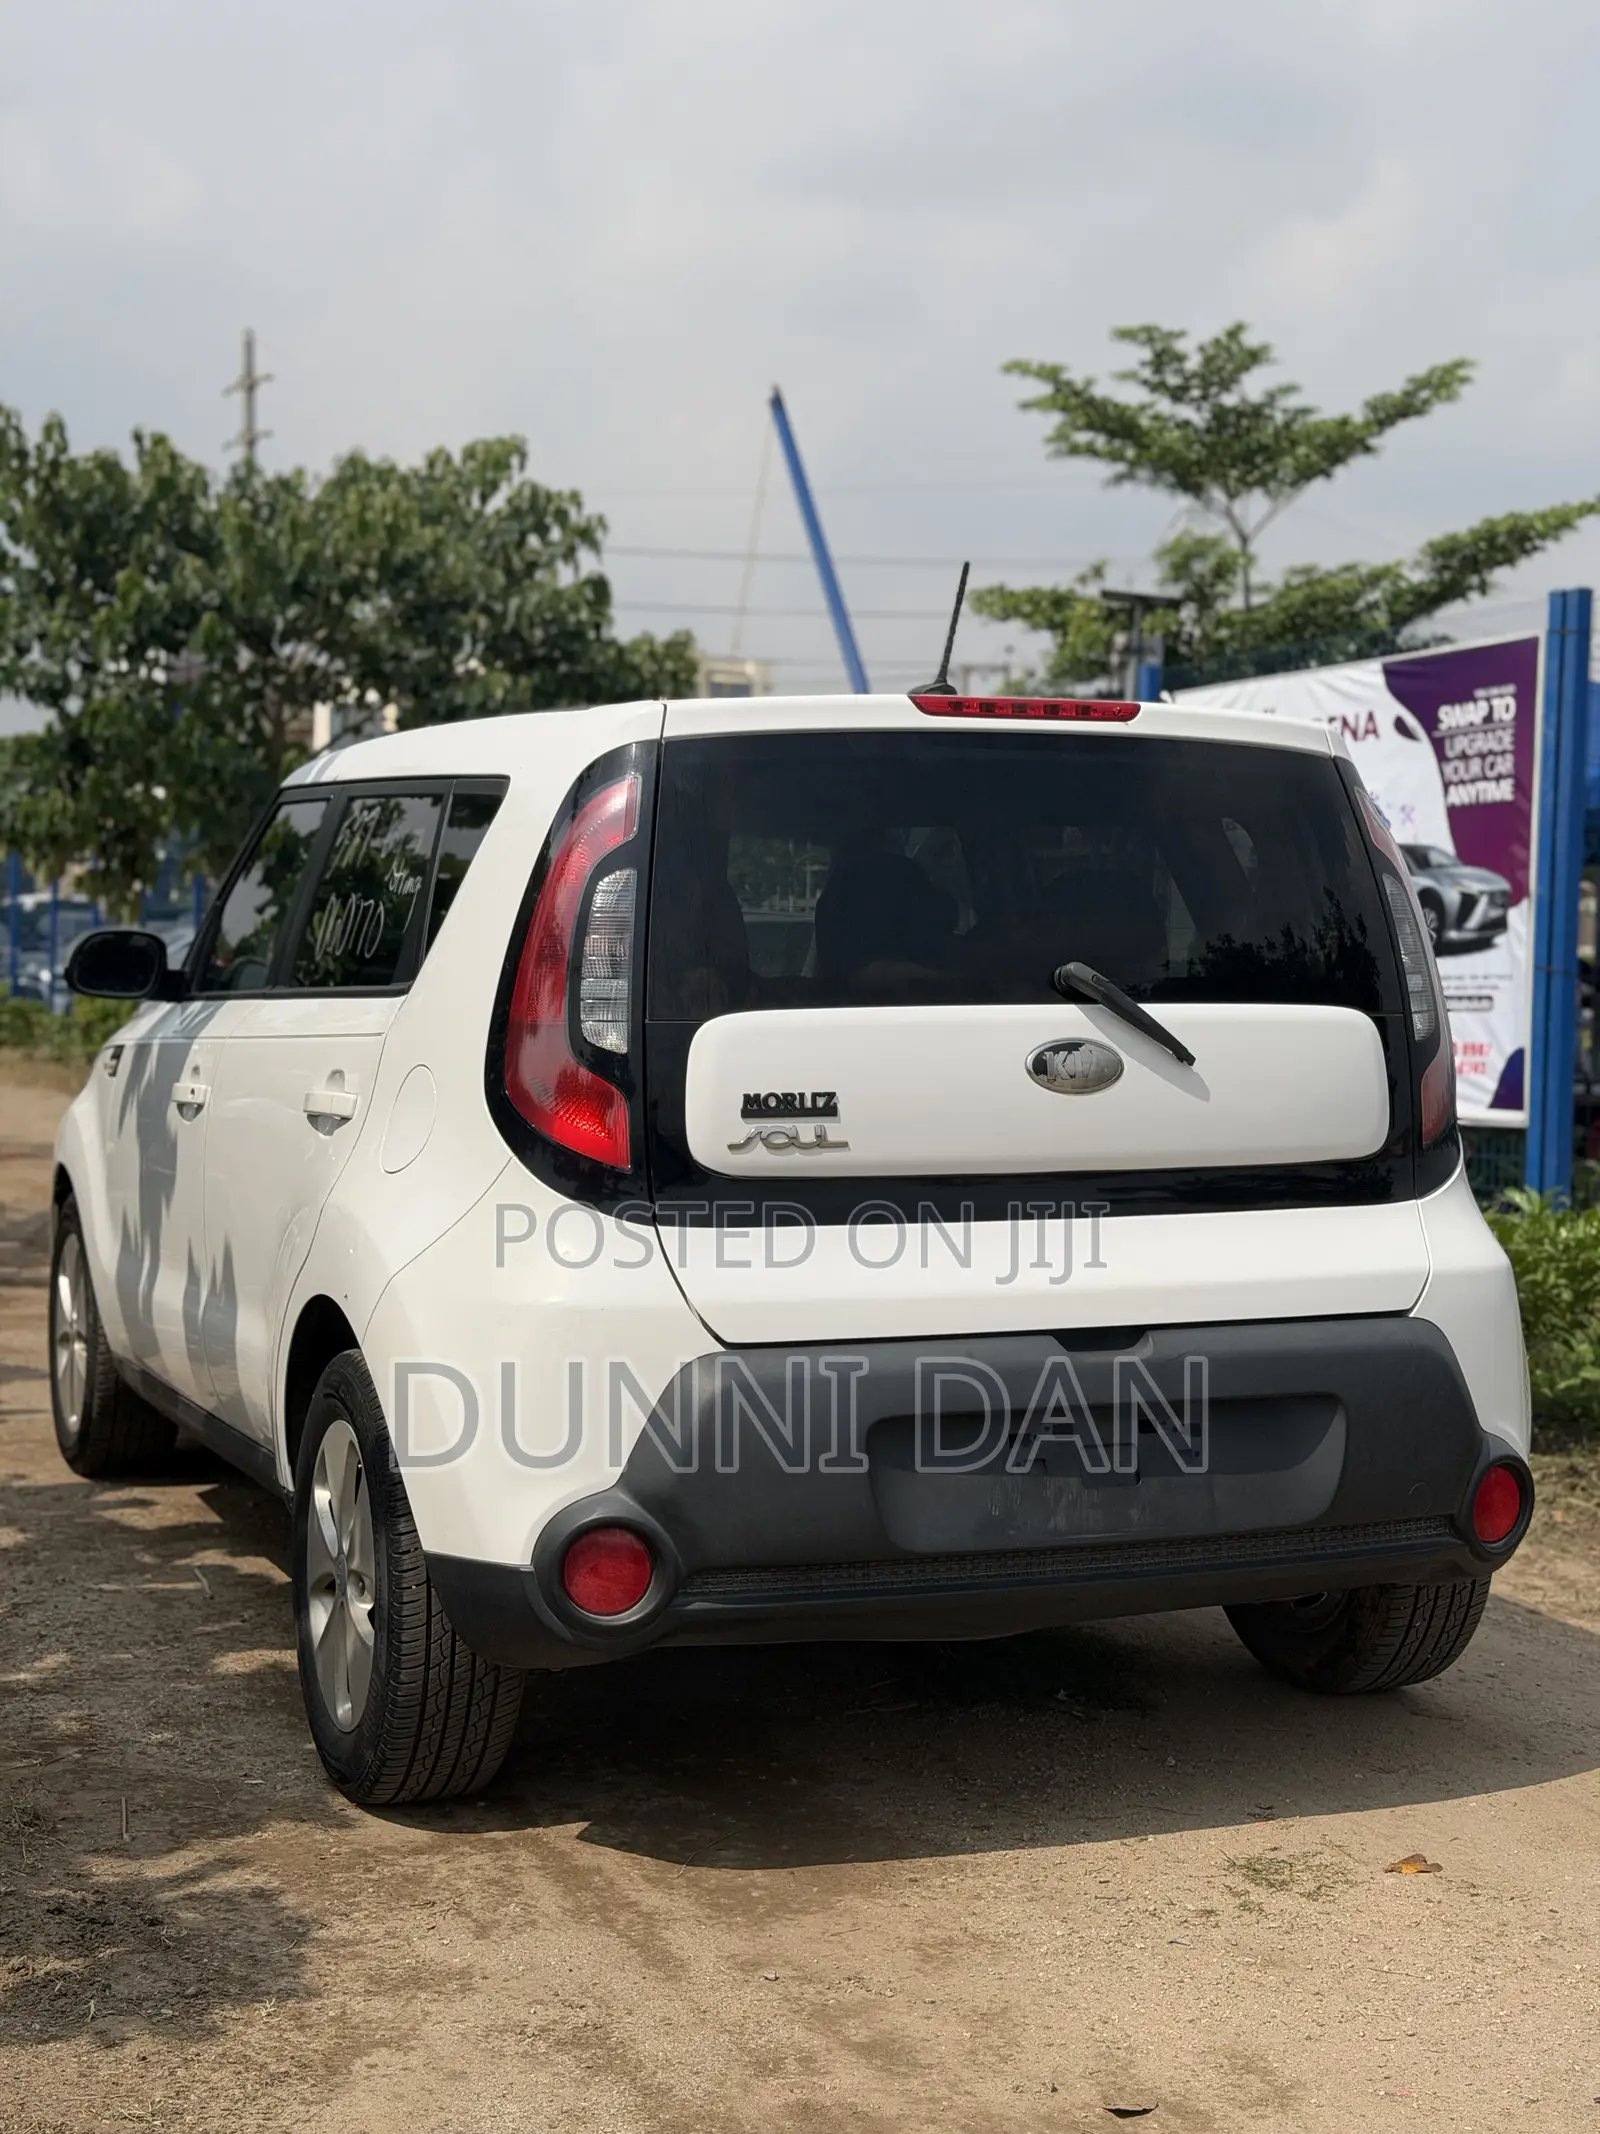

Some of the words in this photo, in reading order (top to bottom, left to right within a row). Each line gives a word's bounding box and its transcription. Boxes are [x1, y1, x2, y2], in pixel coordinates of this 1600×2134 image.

[1437, 700, 1489, 731] SWAP
[1490, 696, 1516, 722] TO
[1444, 729, 1515, 758] UPGRADE
[1441, 757, 1483, 783] YOUR
[1484, 752, 1515, 778] CAR
[1446, 778, 1515, 807] ANYTIME
[727, 1125, 850, 1150] SOUL
